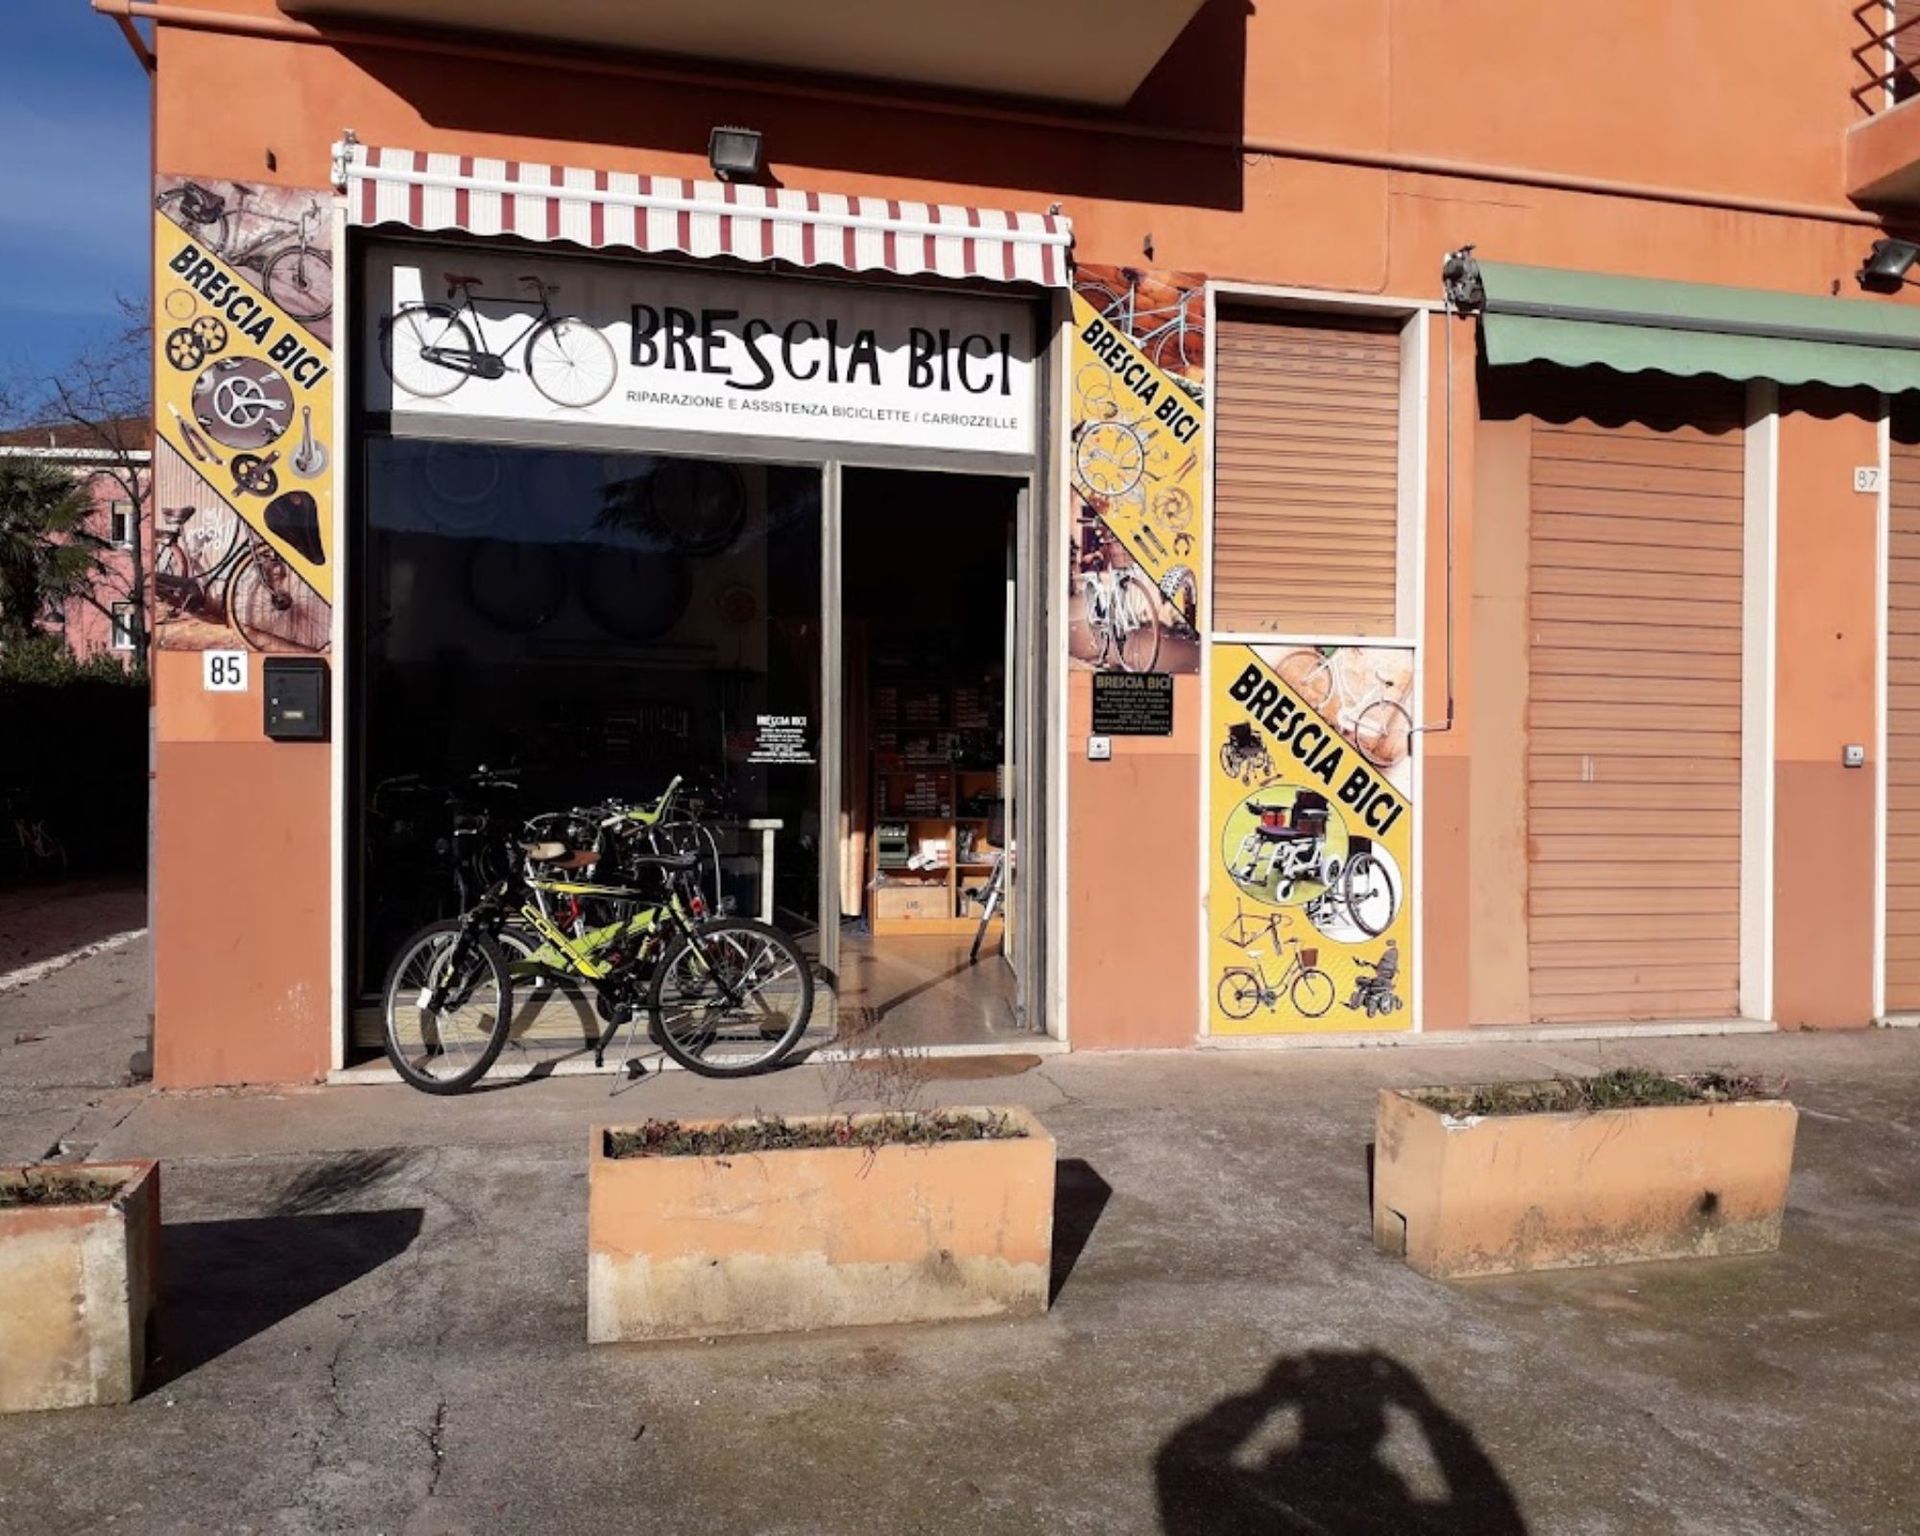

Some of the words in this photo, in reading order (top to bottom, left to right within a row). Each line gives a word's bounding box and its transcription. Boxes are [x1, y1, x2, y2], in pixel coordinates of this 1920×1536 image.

[169, 244, 274, 345] BRESCIA
[267, 333, 329, 390] BICI
[630, 304, 881, 391] BRESCIA
[908, 327, 1011, 396] BICI
[626, 390, 723, 408] RIPARAZIONE
[728, 398, 738, 410] E
[741, 399, 828, 416] ASSISTENZA
[832, 405, 911, 422] BICICLETTE
[922, 412, 1018, 430] CARROZZELLE
[1081, 319, 1160, 406] BRESCIA
[1154, 395, 1200, 444] BICI
[1857, 470, 1878, 489] 87
[211, 656, 241, 685] 85
[1096, 675, 1145, 689] BRESCIA
[1148, 676, 1172, 690] BICI
[1228, 663, 1344, 785] BRESCIA
[1337, 766, 1403, 836] BICI
